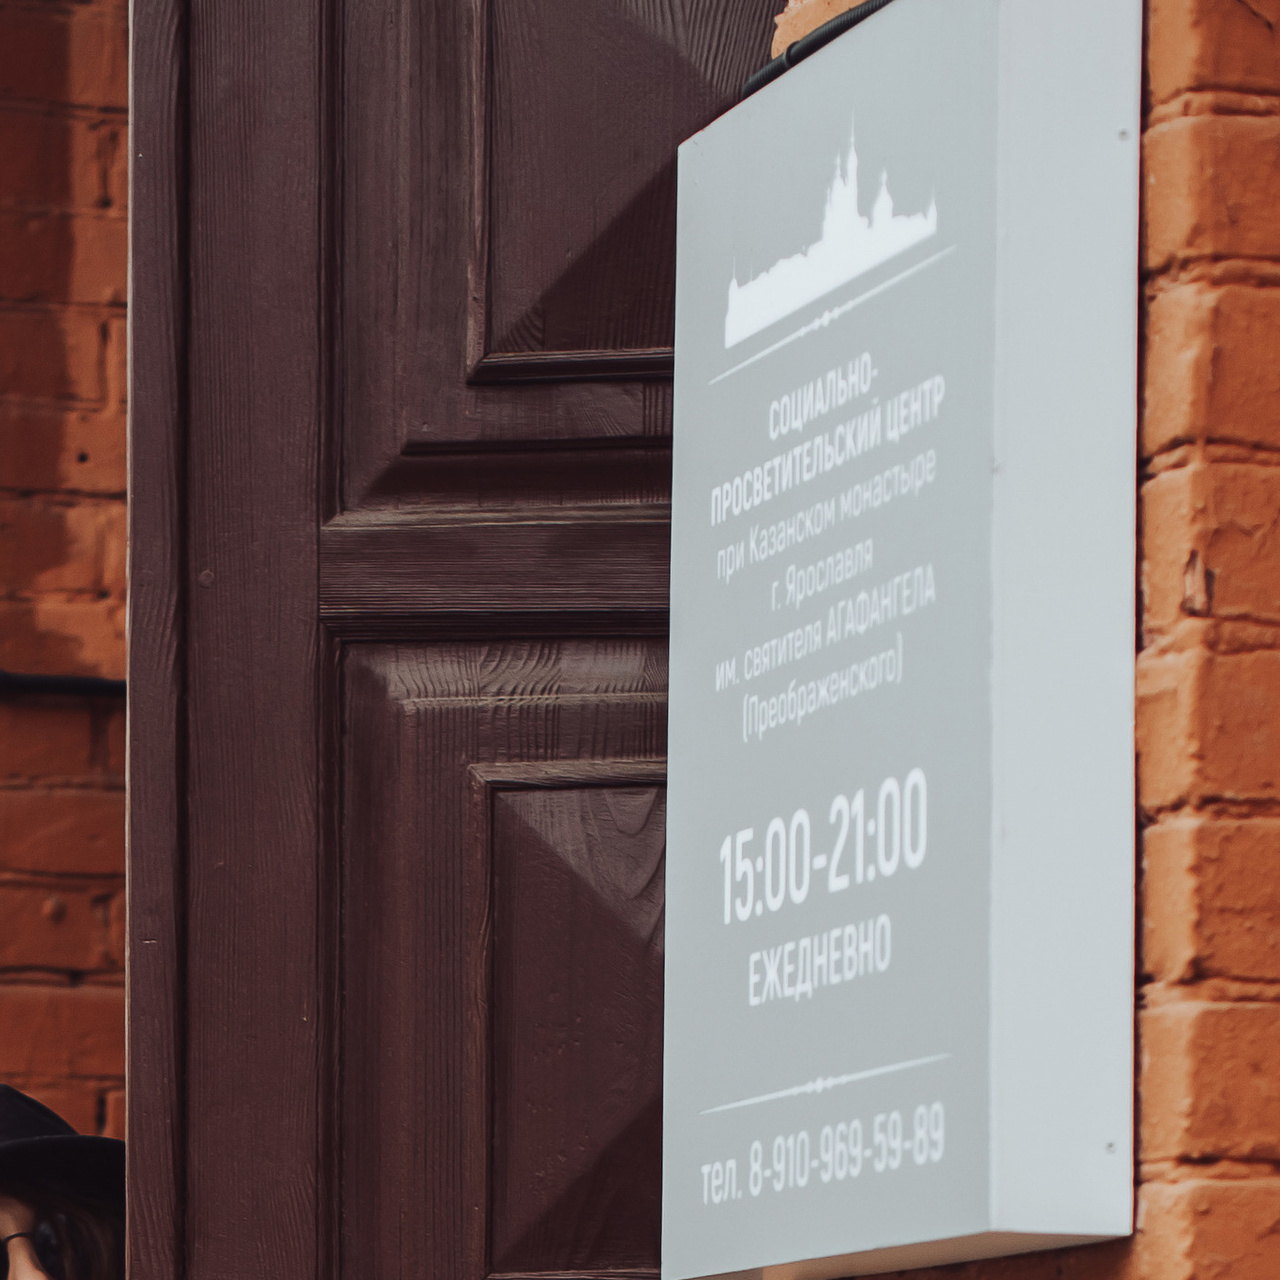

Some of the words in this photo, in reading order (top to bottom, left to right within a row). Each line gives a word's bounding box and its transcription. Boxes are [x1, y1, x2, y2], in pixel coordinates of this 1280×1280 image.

[711, 397, 881, 526] ПРОСВЕТИТЕЛЬСКИЙ
[886, 374, 946, 442] ЦЕНТР
[769, 352, 878, 440] СОЦИАЛЬНО-
[718, 542, 745, 584] при
[750, 495, 835, 563] Казанском
[840, 448, 937, 519] монастыре
[715, 660, 739, 692] им.
[744, 619, 821, 680] святителя
[826, 563, 936, 646] АГАФАНГЕЛА
[771, 579, 781, 611] г.
[786, 538, 873, 608] Ярославля
[742, 632, 903, 743] (Преображенского)
[720, 767, 928, 925] 15:00-21:00
[748, 914, 892, 1007] ЕЖЕДНЕВНО
[701, 1155, 742, 1205] тел.
[749, 1101, 945, 1197] 8-910-969-59-89
